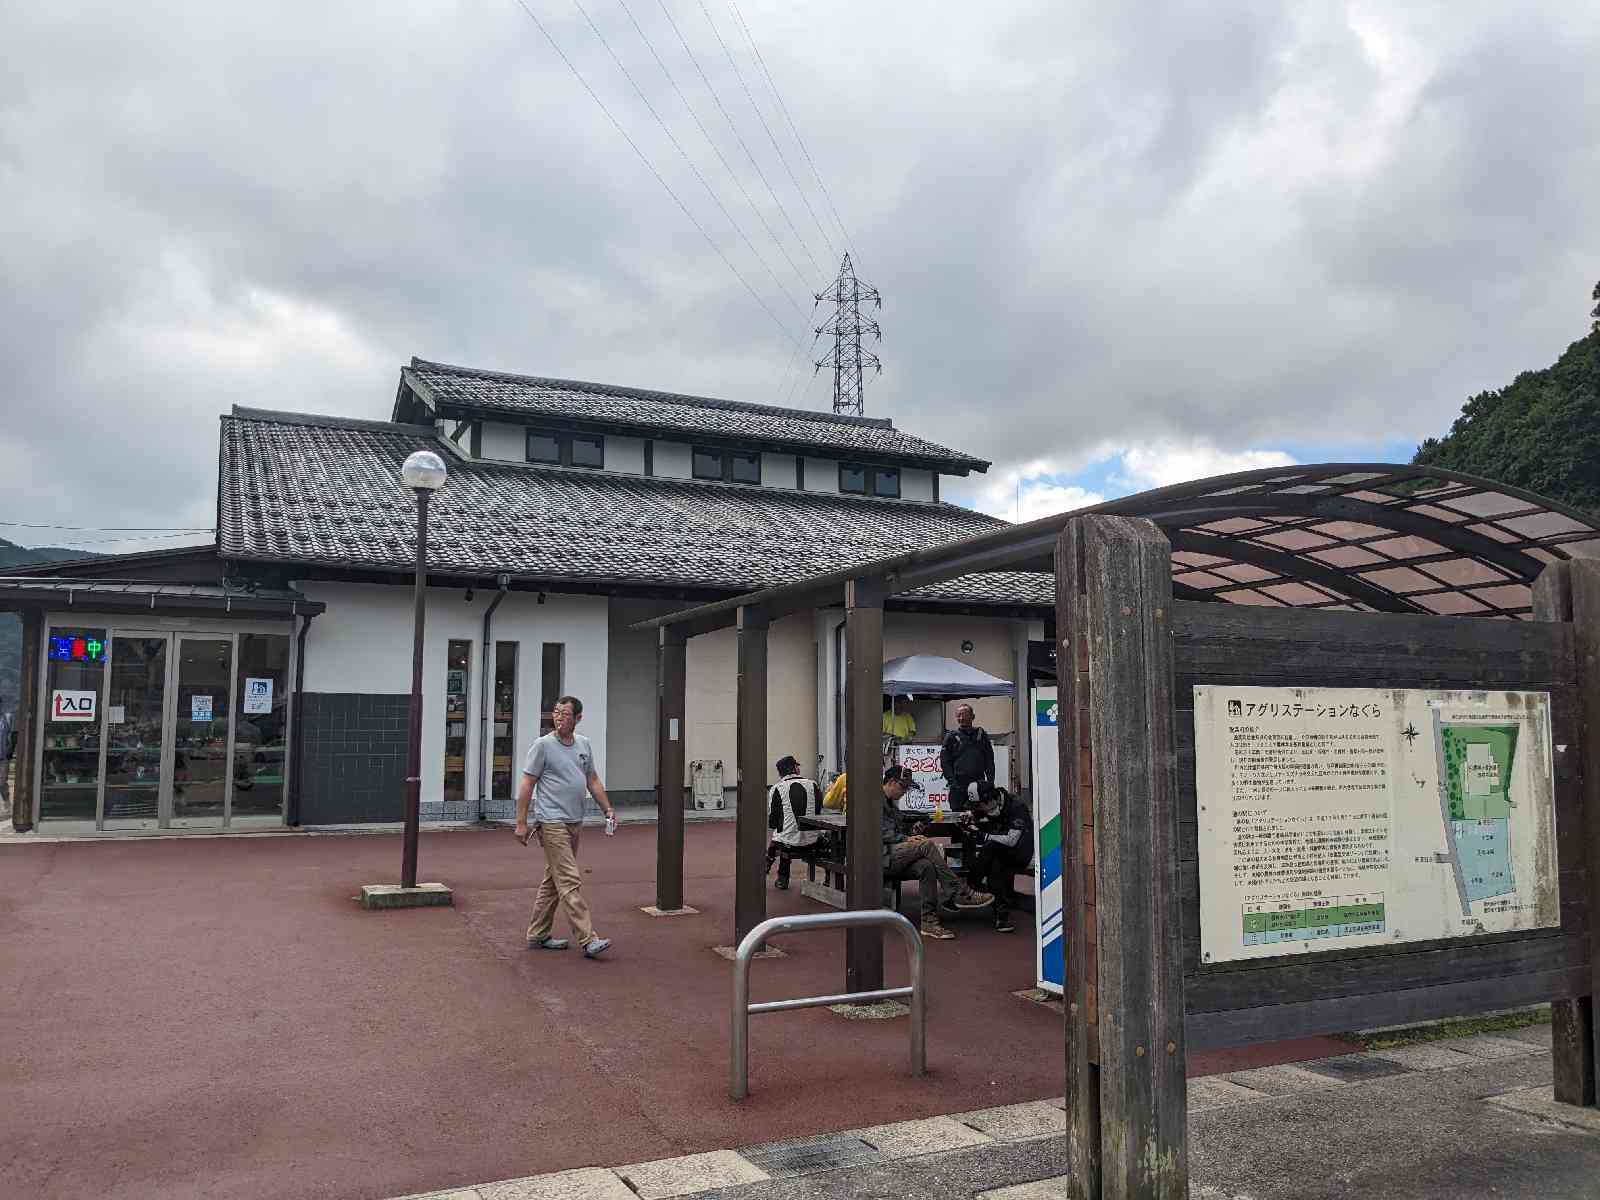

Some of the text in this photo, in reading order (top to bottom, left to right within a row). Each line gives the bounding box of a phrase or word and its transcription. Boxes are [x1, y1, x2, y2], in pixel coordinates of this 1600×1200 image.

[62, 697, 92, 711] 入口
[1246, 703, 1381, 718] アグリステーションなぐら
